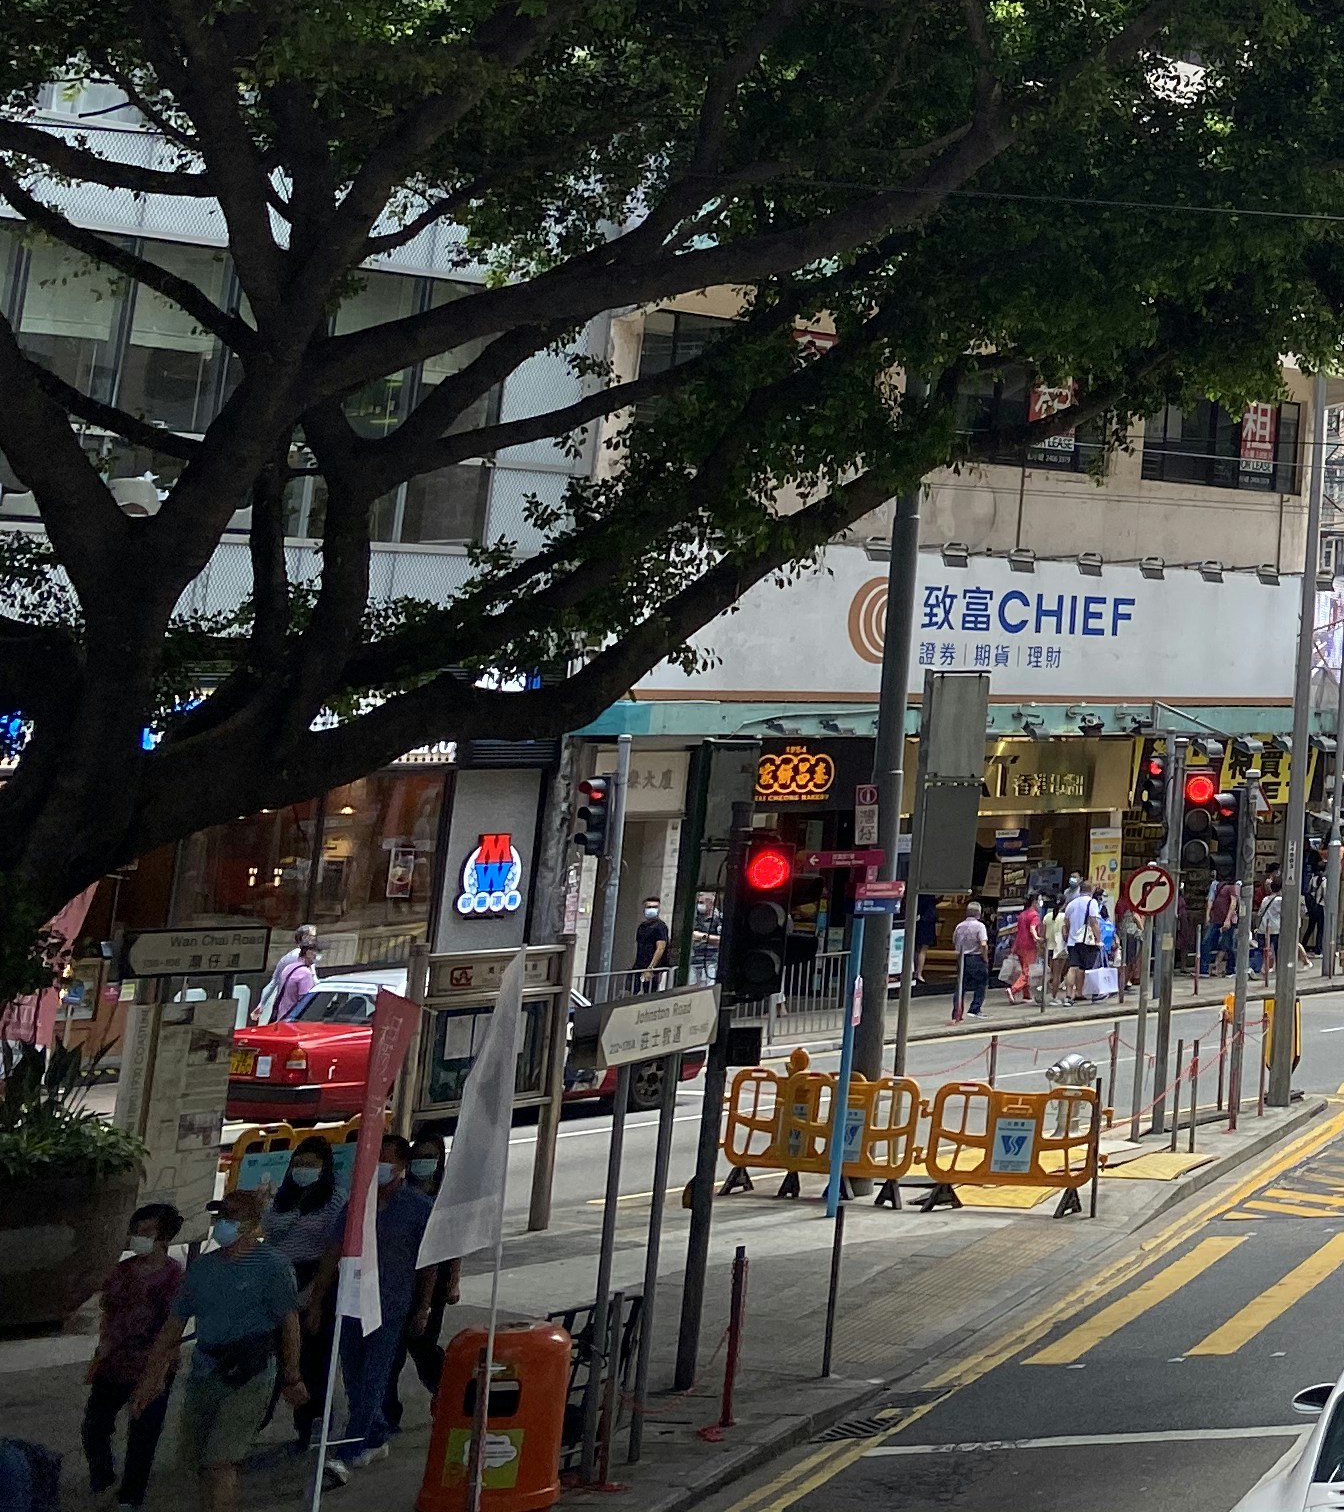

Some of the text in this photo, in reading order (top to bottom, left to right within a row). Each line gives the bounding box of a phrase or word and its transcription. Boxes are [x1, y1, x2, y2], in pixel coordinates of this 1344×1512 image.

[920, 584, 993, 632] 致富
[998, 589, 1136, 637] CHIEF
[918, 642, 1062, 669] 證券 期貨 理財
[169, 934, 265, 947] Wan Chai Road
[634, 997, 692, 1025] Johnston Road
